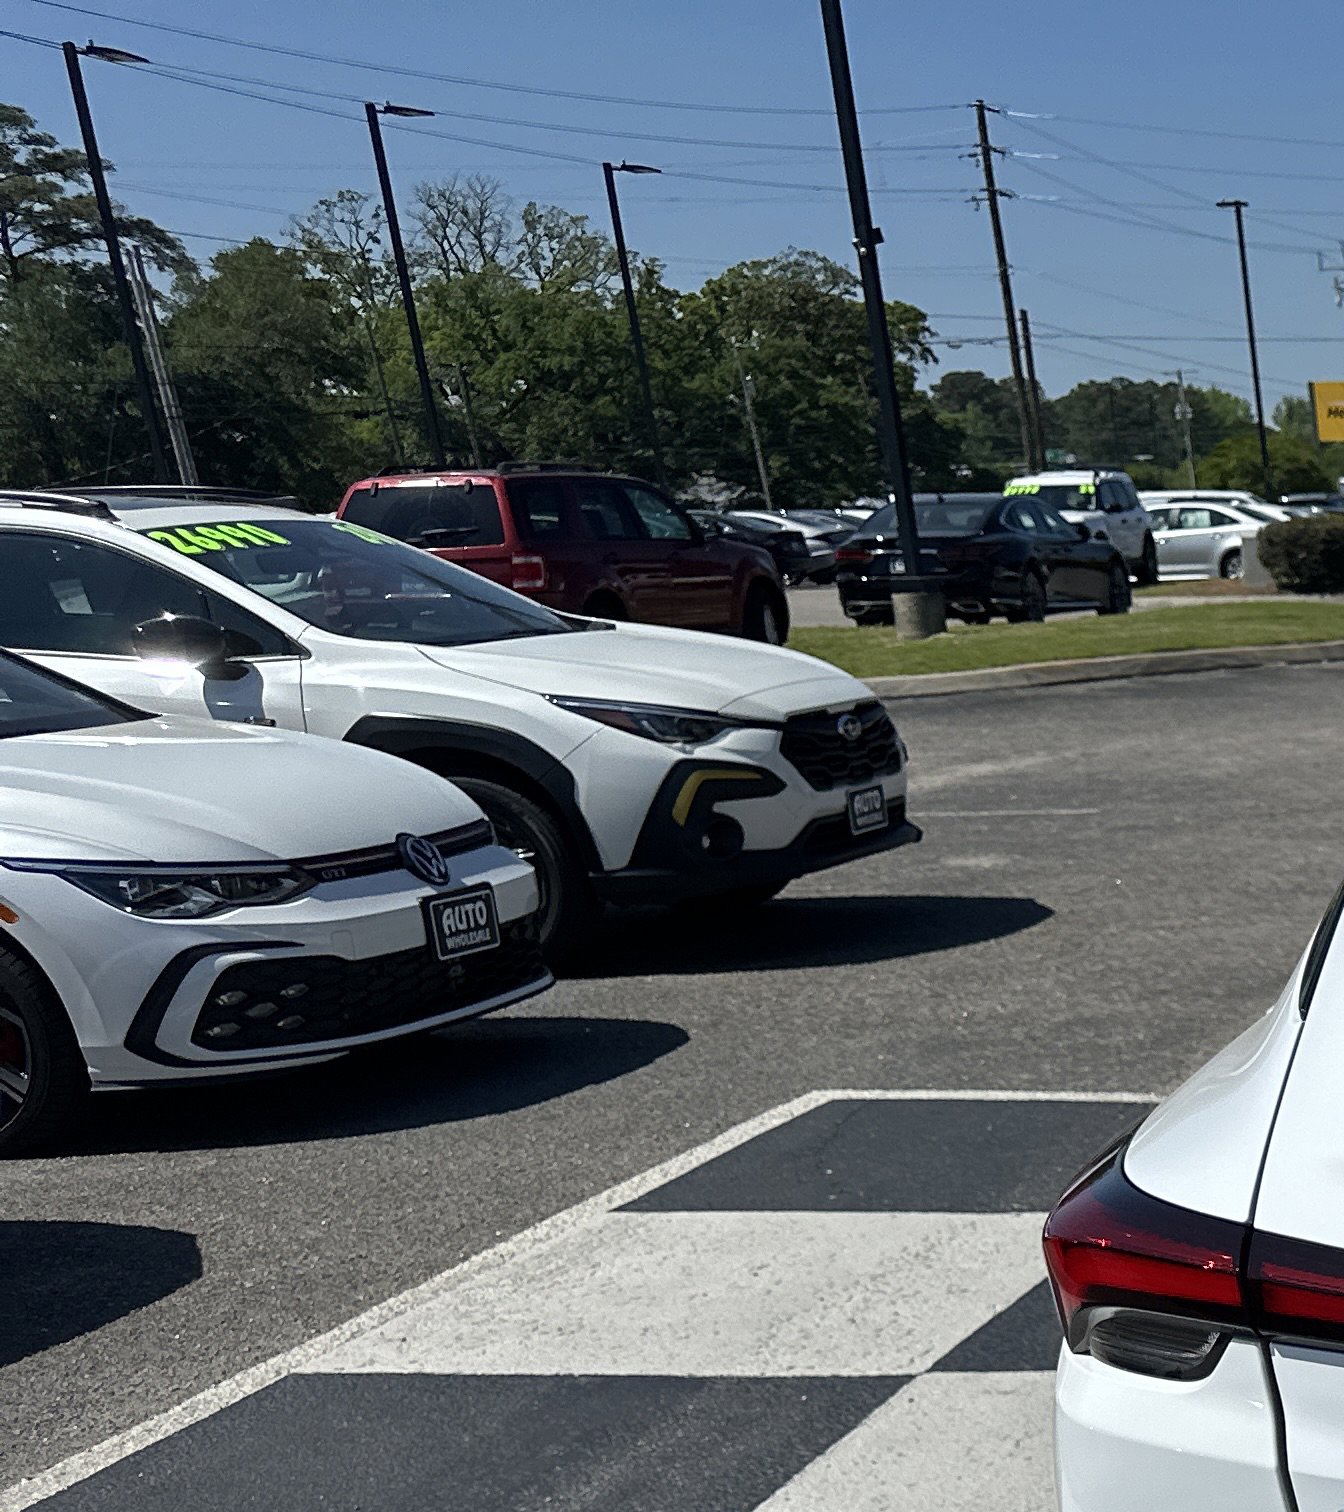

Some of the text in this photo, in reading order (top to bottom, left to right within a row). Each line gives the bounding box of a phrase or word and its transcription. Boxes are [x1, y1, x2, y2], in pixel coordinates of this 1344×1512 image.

[321, 867, 347, 880] GTI
[442, 900, 487, 936] AUTO
[445, 927, 491, 950] WHOLESALE
